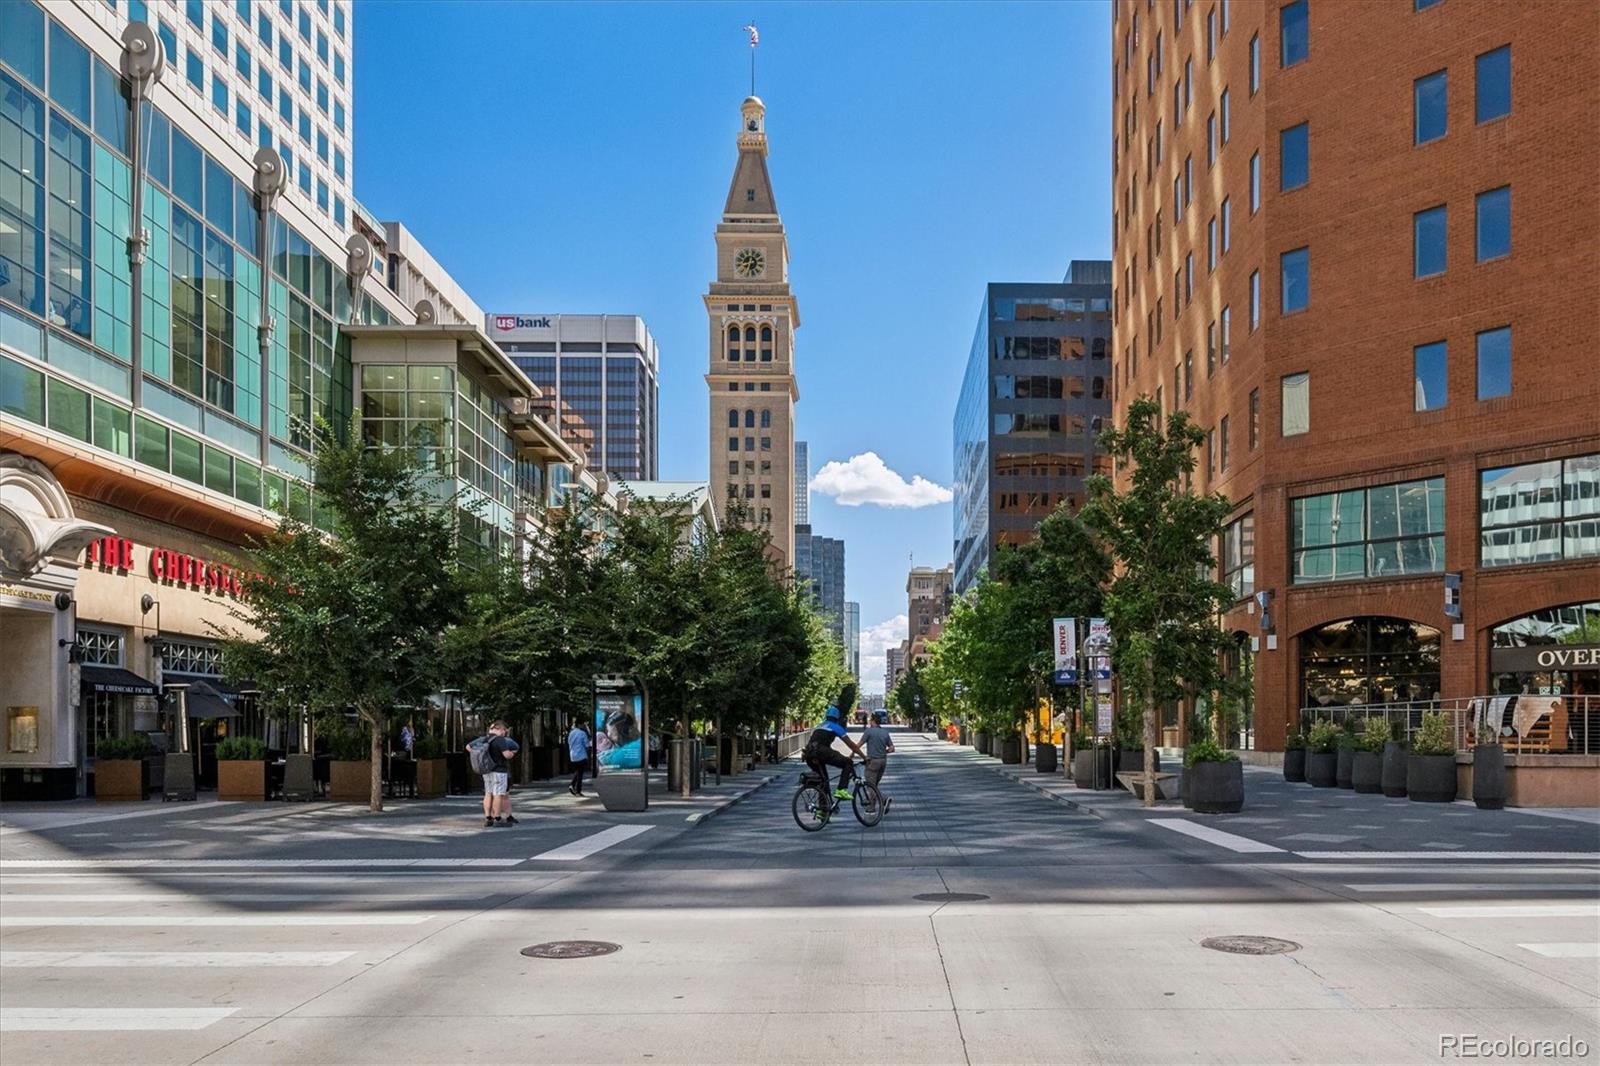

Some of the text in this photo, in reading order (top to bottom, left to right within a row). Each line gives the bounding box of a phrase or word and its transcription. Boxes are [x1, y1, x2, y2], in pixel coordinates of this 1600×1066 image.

[86, 535, 278, 598] THE CHEESEC
[1059, 625, 1067, 656] DENVER
[106, 685, 134, 693] CHEESECAKE
[135, 686, 153, 694] FACTORY
